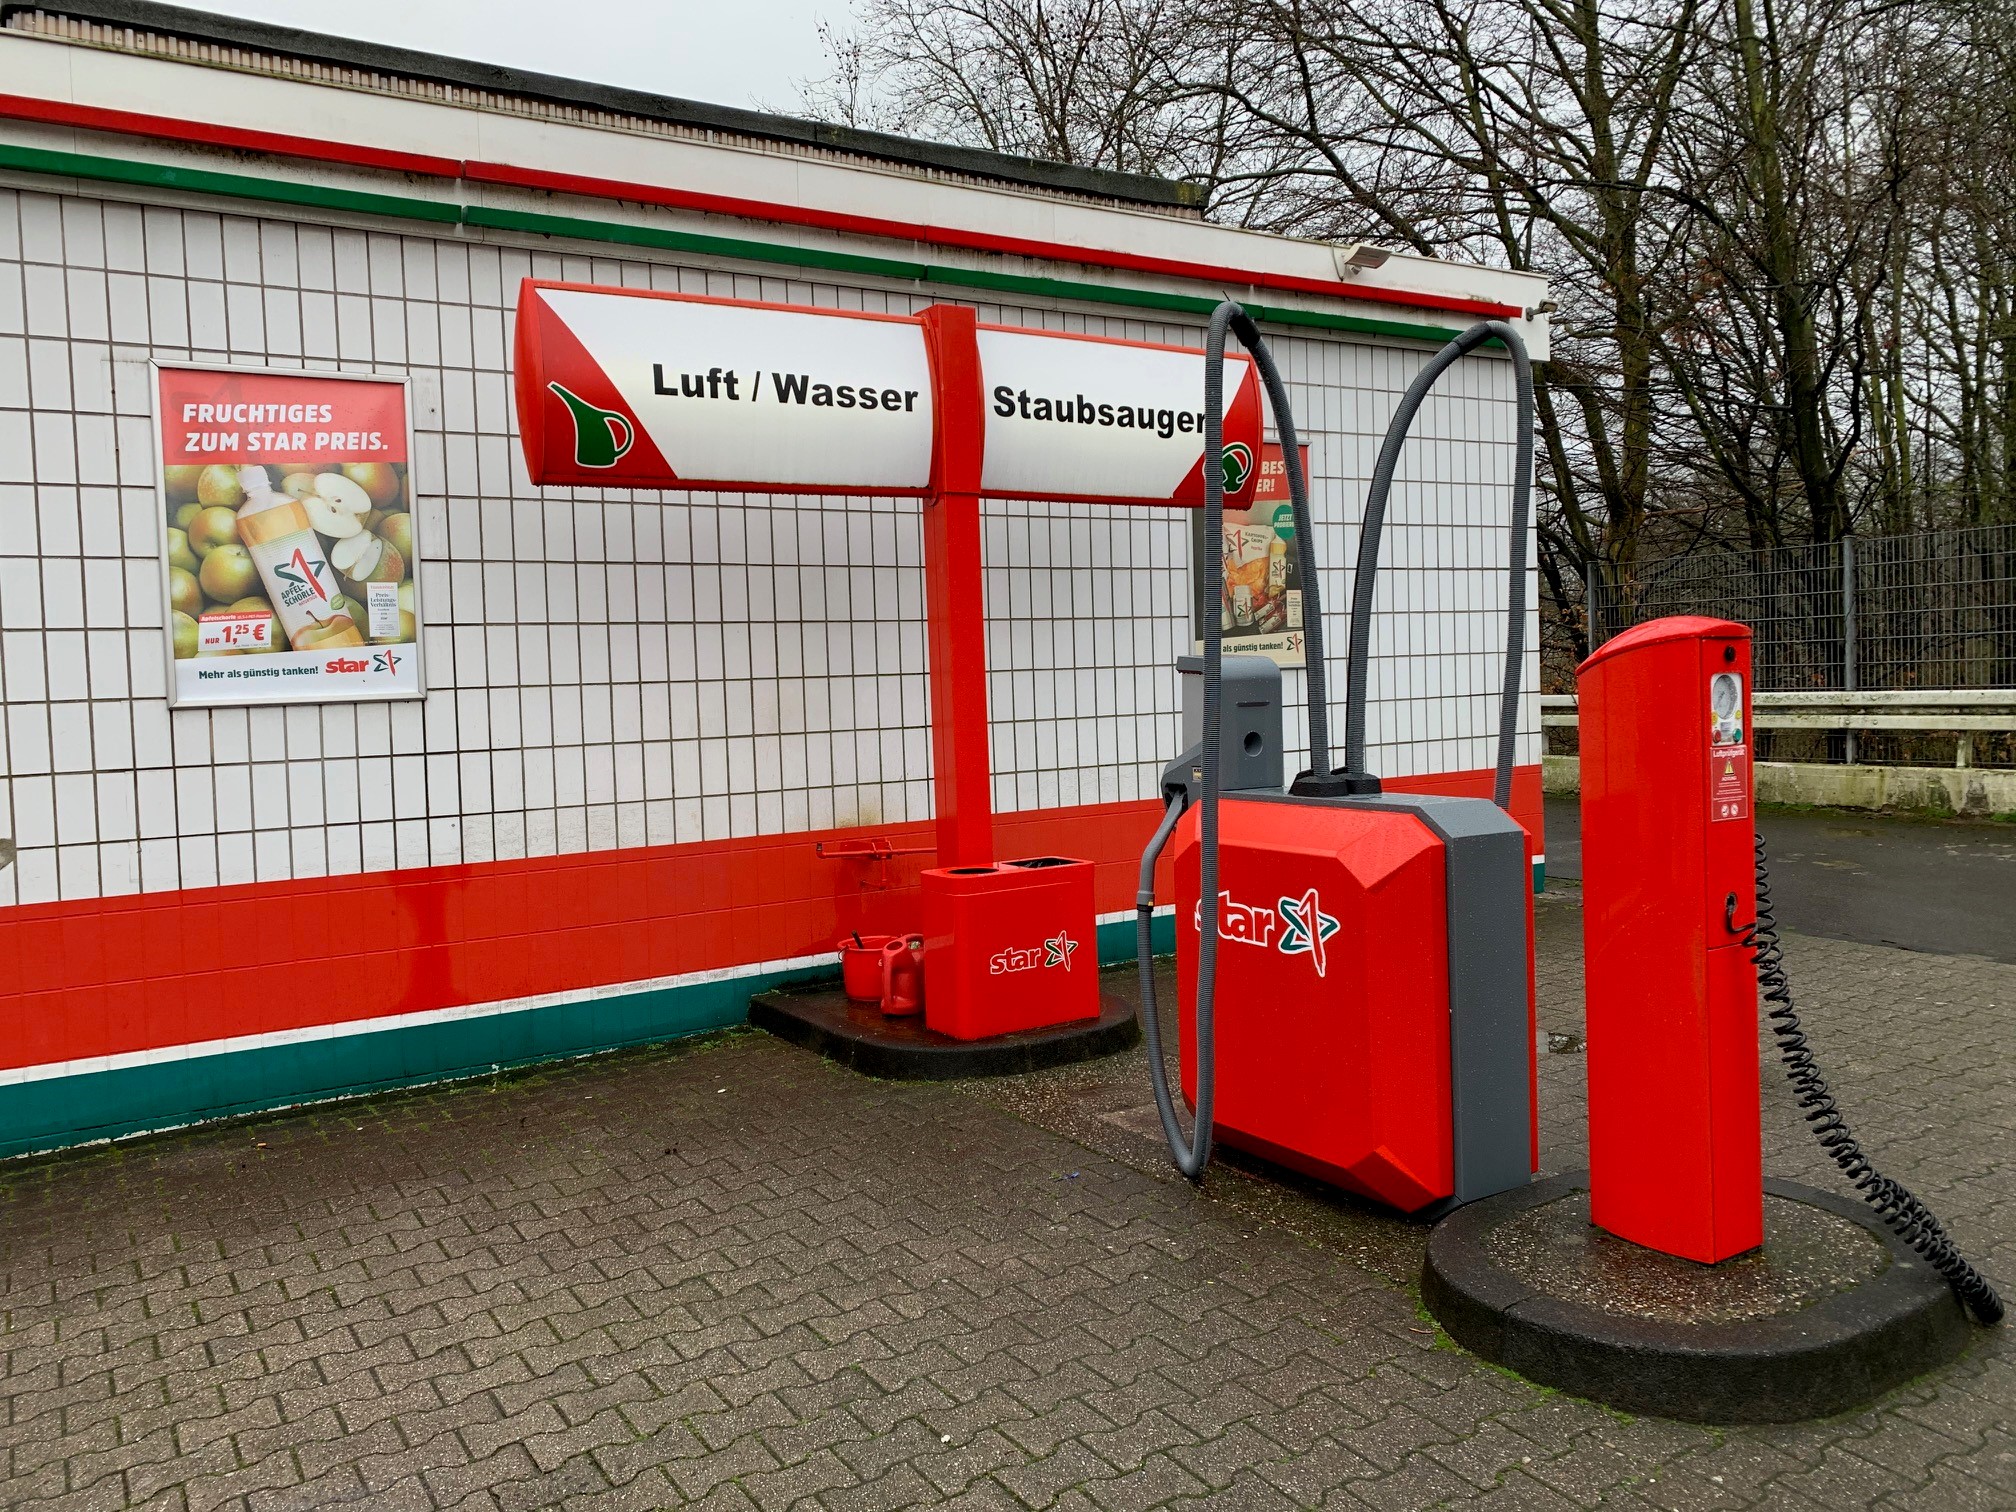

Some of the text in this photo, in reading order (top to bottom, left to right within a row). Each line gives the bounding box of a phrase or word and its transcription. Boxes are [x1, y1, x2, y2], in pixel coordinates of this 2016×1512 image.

[652, 363, 919, 412] Luft / Wasser
[182, 403, 333, 423] FRUCHTIGES
[993, 385, 1205, 439] Staubsauger
[184, 432, 389, 452] ZUM STAR PREIS.
[281, 584, 305, 600] APFEL-
[284, 587, 316, 607] SCHORLE
[205, 623, 266, 645] NUR 1,25 €
[1222, 641, 1284, 653] als günstig tanken!
[198, 666, 319, 680] Mehr als günstig tanken!
[325, 657, 370, 674] star
[1194, 889, 1275, 948] tar
[989, 946, 1042, 975] star
